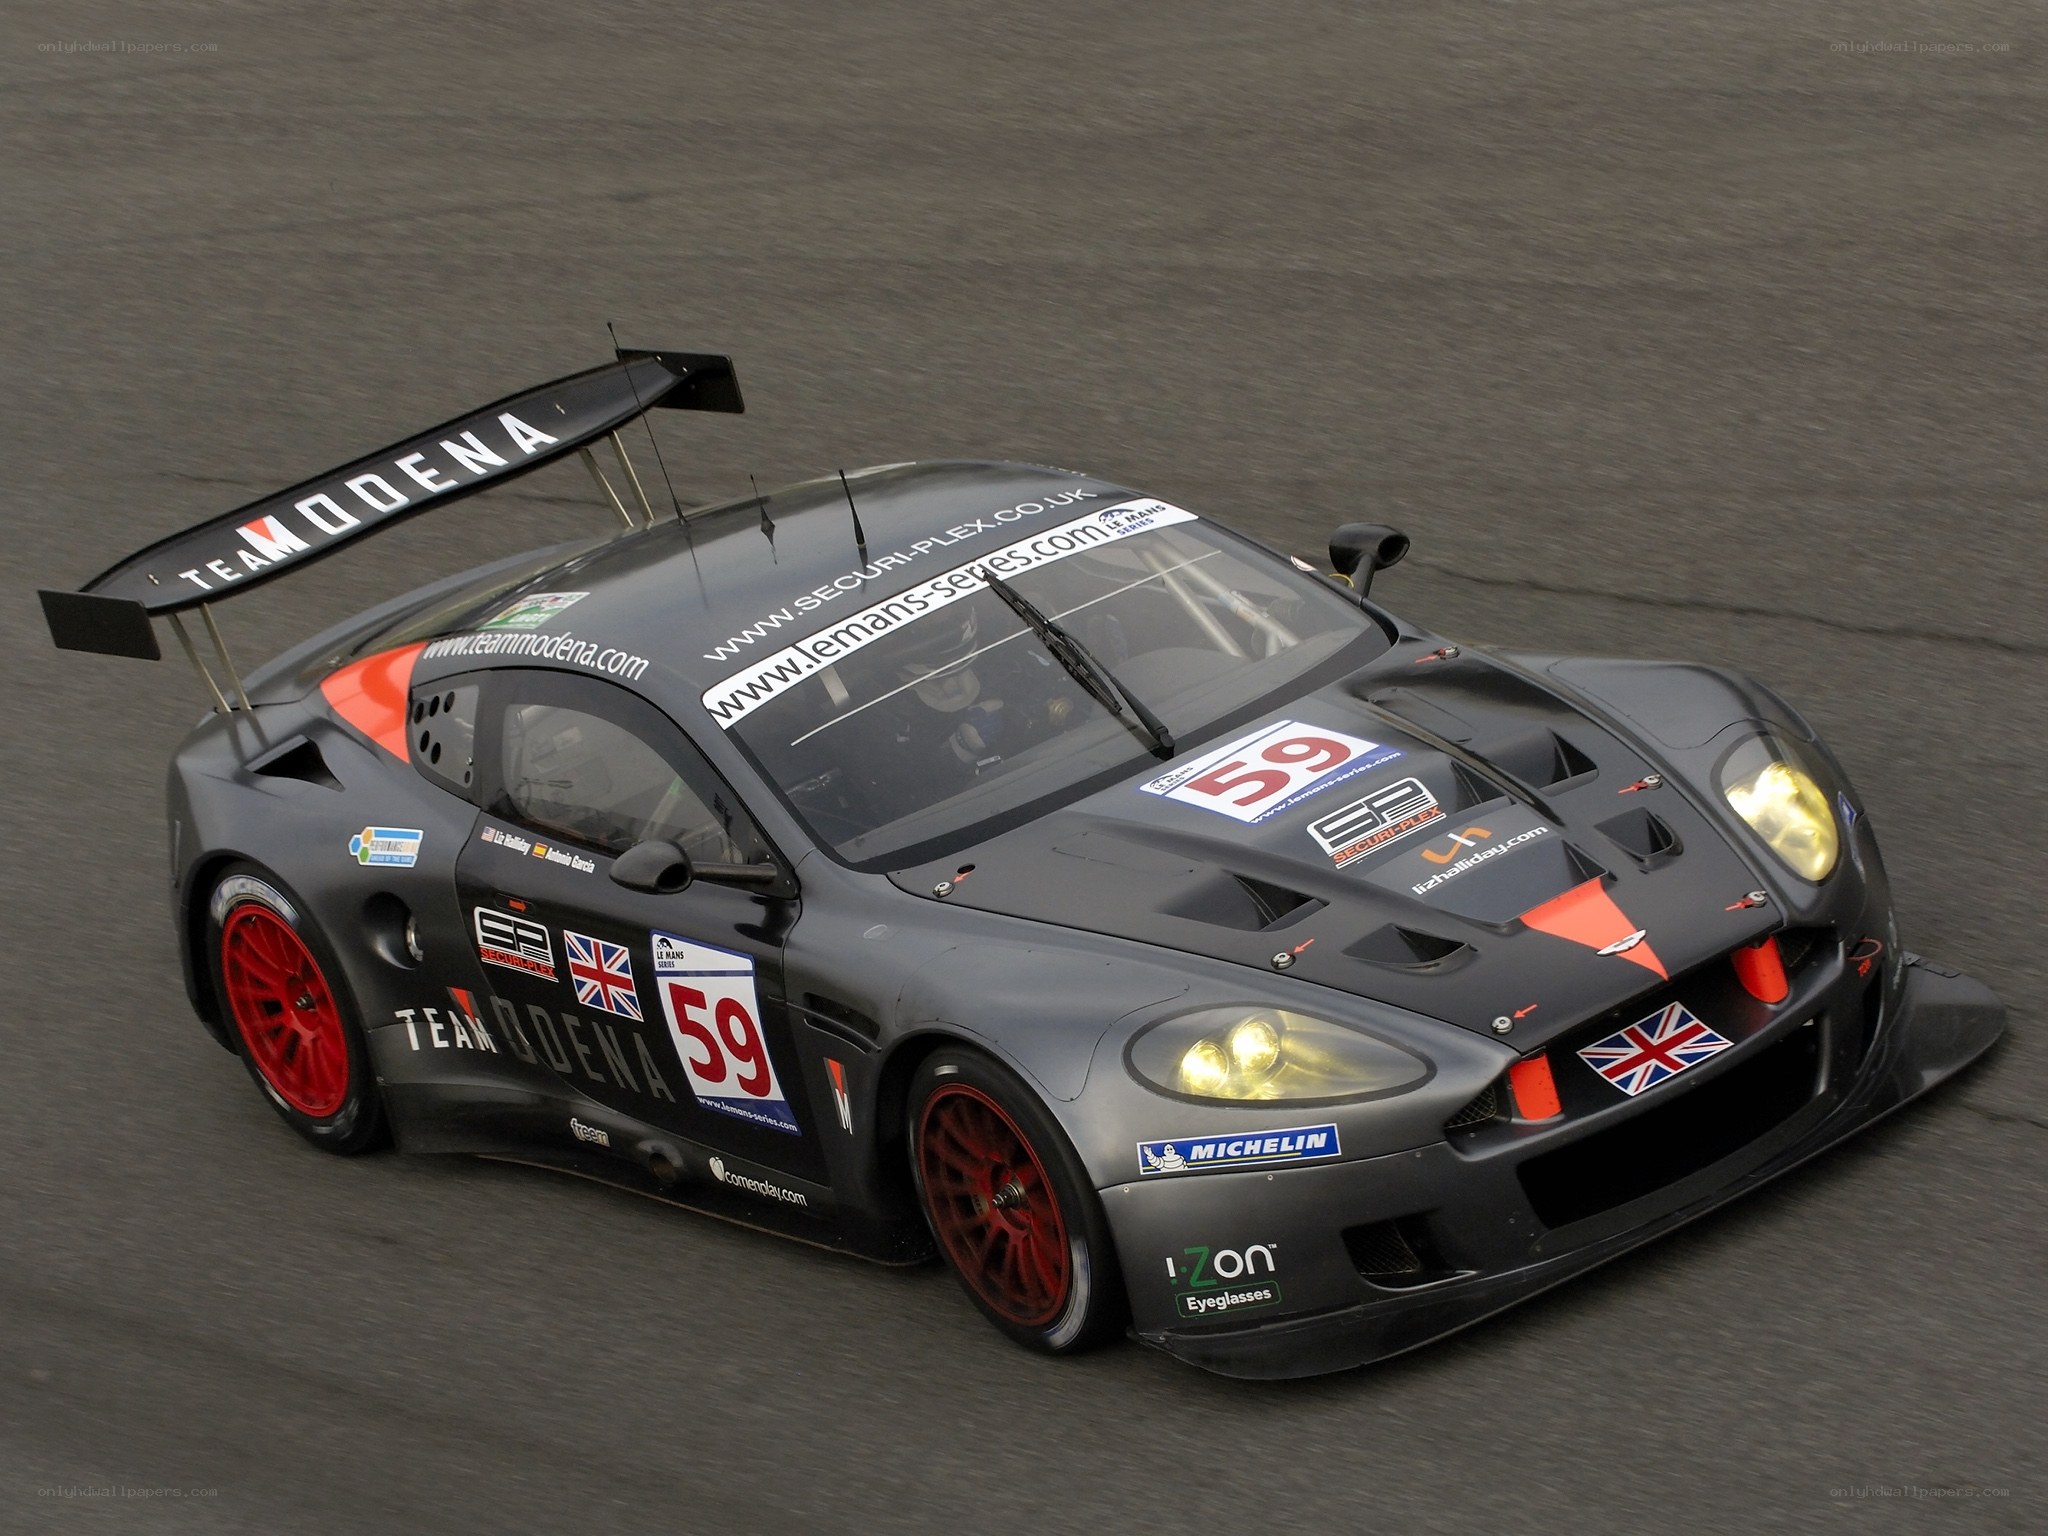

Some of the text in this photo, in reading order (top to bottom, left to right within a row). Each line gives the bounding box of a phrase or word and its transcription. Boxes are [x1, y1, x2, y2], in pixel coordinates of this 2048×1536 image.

[1106, 504, 1167, 530] LE MANS
[1116, 518, 1154, 536] SERIES
[703, 488, 1098, 663] WWW.SECURI-PLEX.CO.UK
[422, 631, 650, 681] www.teammodena.com
[1183, 736, 1352, 807] 59
[1250, 751, 1401, 824] www.lemans-series.com
[493, 830, 505, 845] Liz
[1333, 806, 1442, 865] SECURI-PLEX
[545, 847, 572, 866] Antonio
[1411, 826, 1549, 895] lizhalliday.com
[479, 948, 556, 978] SECURI-PLEX
[656, 951, 684, 960] LE MANS
[668, 982, 771, 1097] 59
[697, 1096, 798, 1132] www.lemans-series.com
[1190, 1132, 1328, 1161] MICHELIN
[1186, 1289, 1273, 1312] Eyeglasses
